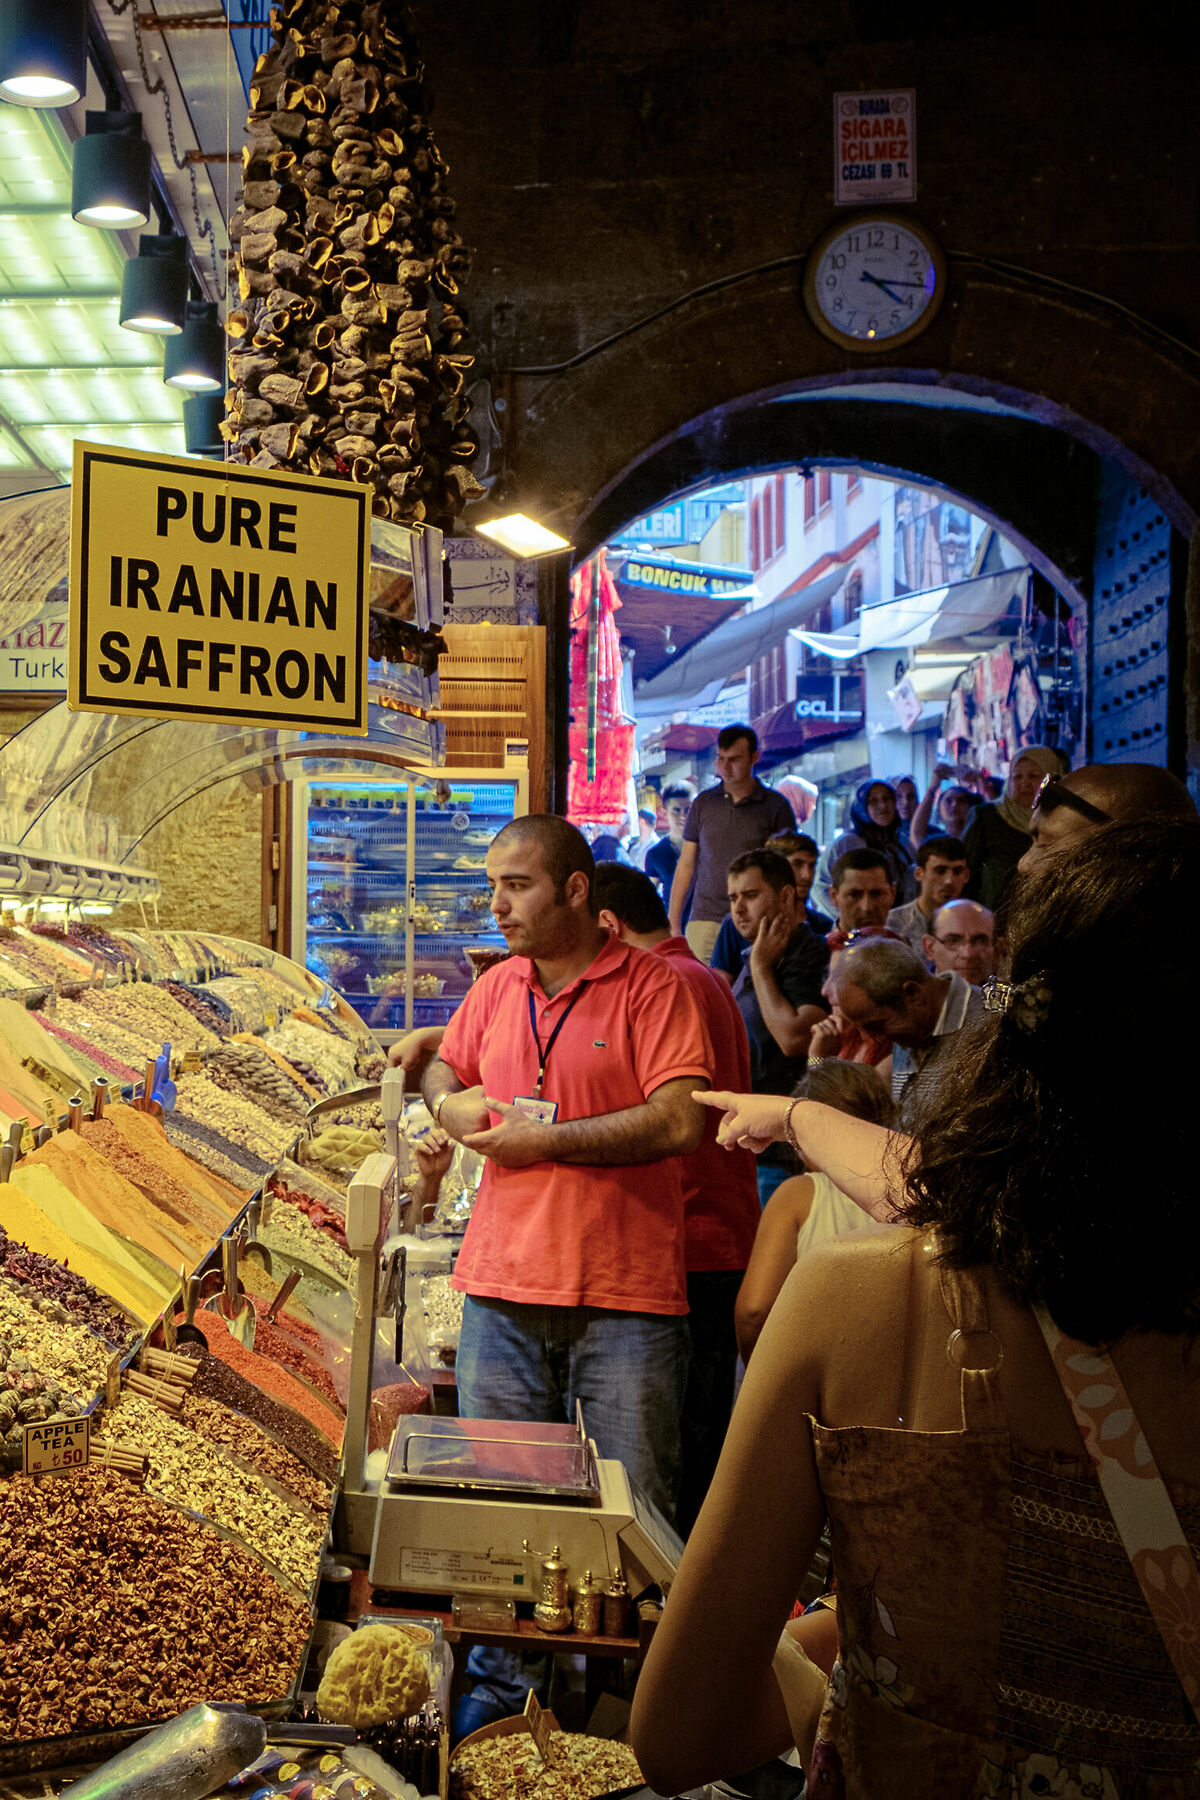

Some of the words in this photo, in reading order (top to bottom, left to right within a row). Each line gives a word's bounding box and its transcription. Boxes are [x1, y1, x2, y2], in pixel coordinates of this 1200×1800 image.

[847, 235, 860, 252] 11
[866, 229, 885, 248] 12
[894, 234, 900, 250] 1
[830, 253, 847, 270] 10
[908, 250, 920, 267] 2
[826, 274, 837, 290] 9
[913, 271, 924, 286] 3
[832, 297, 844, 313] 8
[903, 294, 914, 310] 4
[847, 310, 857, 327] 7
[867, 313, 880, 331] 6
[889, 309, 901, 325] 5
[157, 486, 297, 554] PURE
[627, 562, 708, 594] BONCUK
[110, 555, 338, 631] IRANIAN
[8, 656, 67, 678] Turk
[98, 630, 346, 703] SAFFRON
[31, 1422, 85, 1441] APPLE
[40, 1436, 75, 1451] TEA
